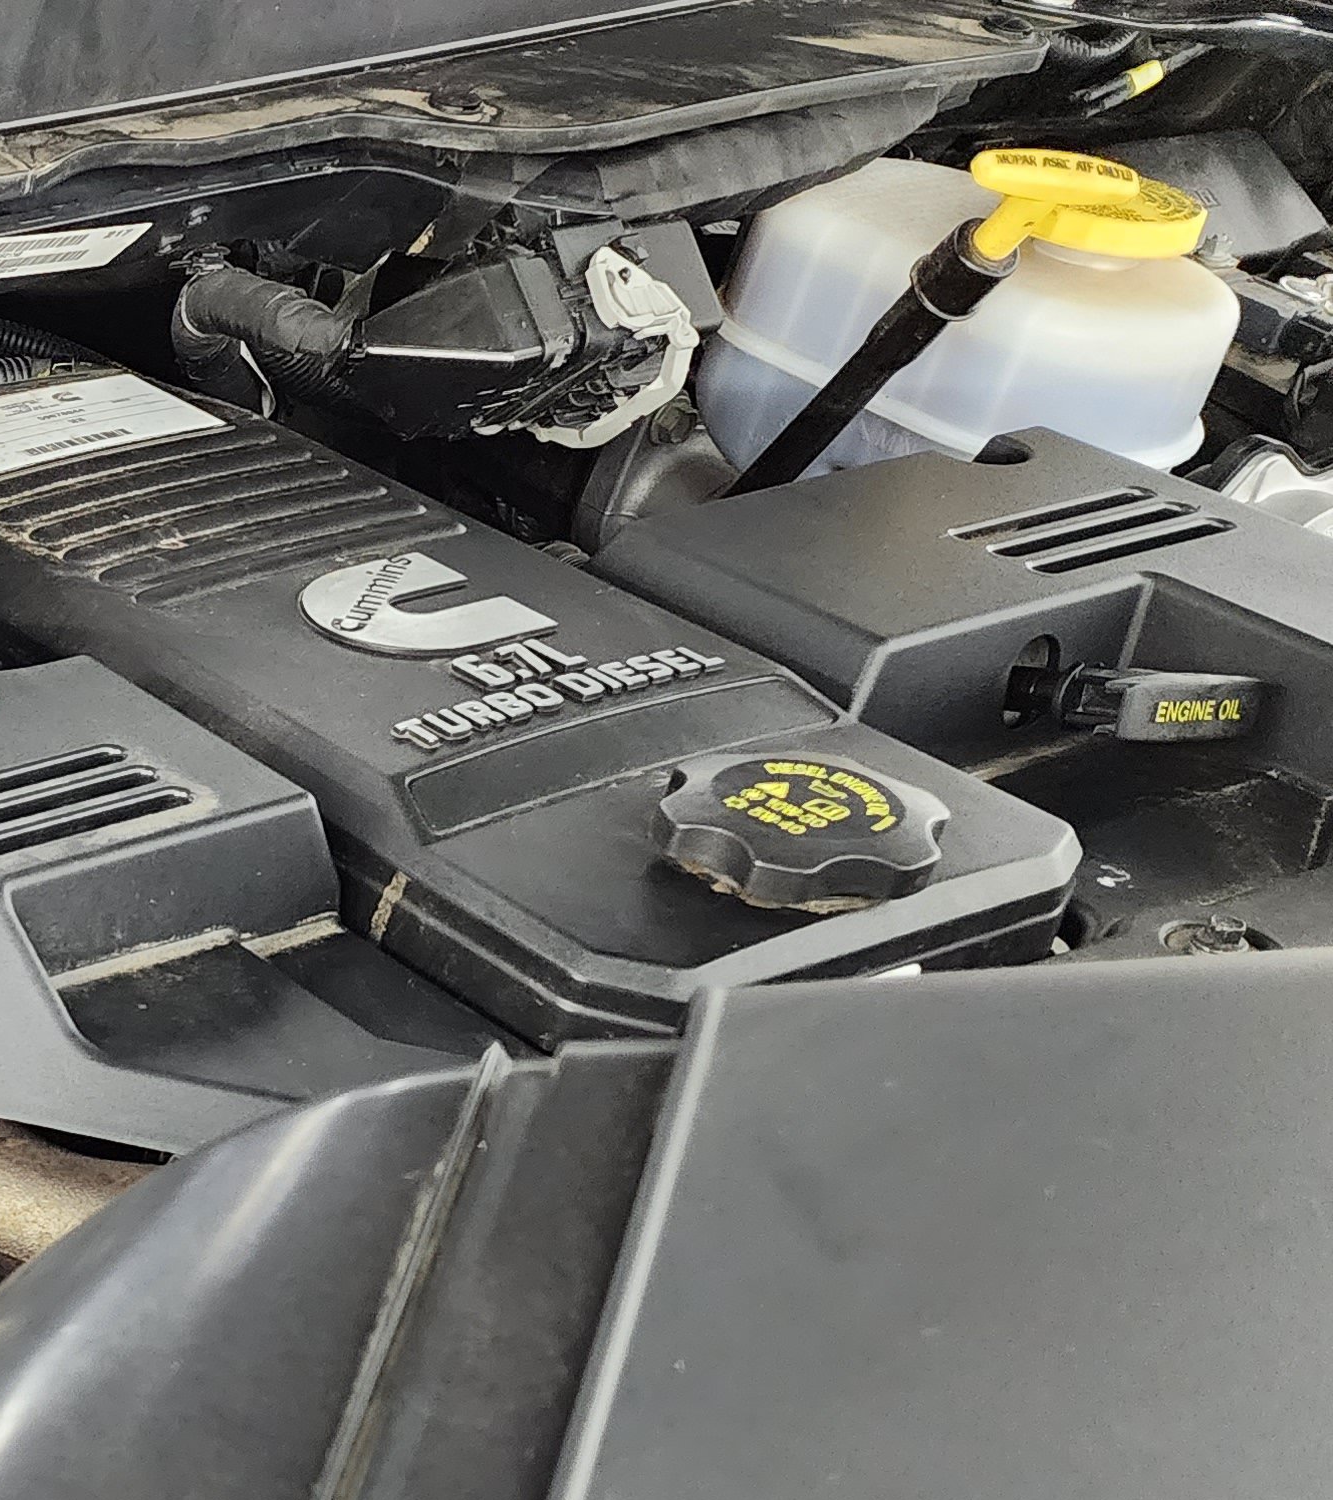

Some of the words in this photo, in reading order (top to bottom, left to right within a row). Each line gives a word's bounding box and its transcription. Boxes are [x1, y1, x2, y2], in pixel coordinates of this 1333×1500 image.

[330, 555, 414, 634] Cummins
[451, 638, 589, 690] 6.7L
[391, 683, 564, 749] TURBO
[554, 646, 726, 702] DIESEL
[1154, 700, 1214, 723] ENGINE
[1218, 698, 1243, 721] OIL
